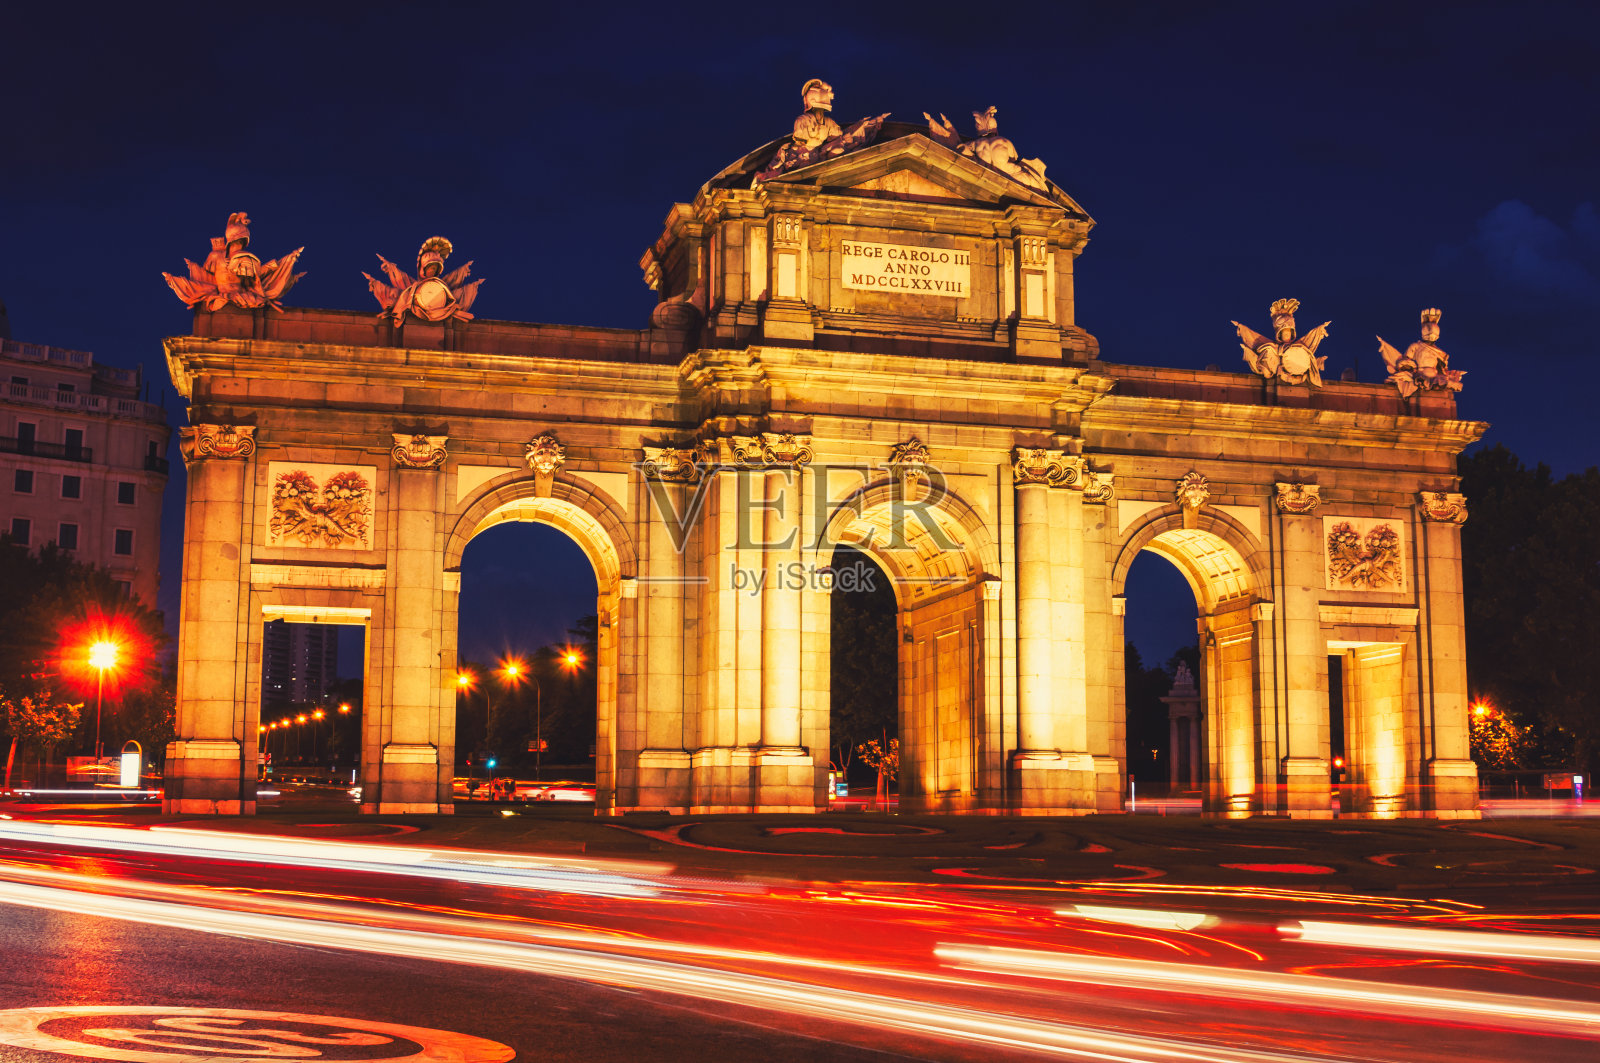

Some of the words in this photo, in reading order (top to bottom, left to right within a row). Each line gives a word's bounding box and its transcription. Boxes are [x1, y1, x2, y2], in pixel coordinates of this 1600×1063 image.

[842, 245, 883, 258] REGE
[888, 248, 949, 264] CAROLO
[954, 254, 970, 266] III
[884, 262, 931, 276] ANNO
[851, 274, 962, 293] MDCCLXXVIII
